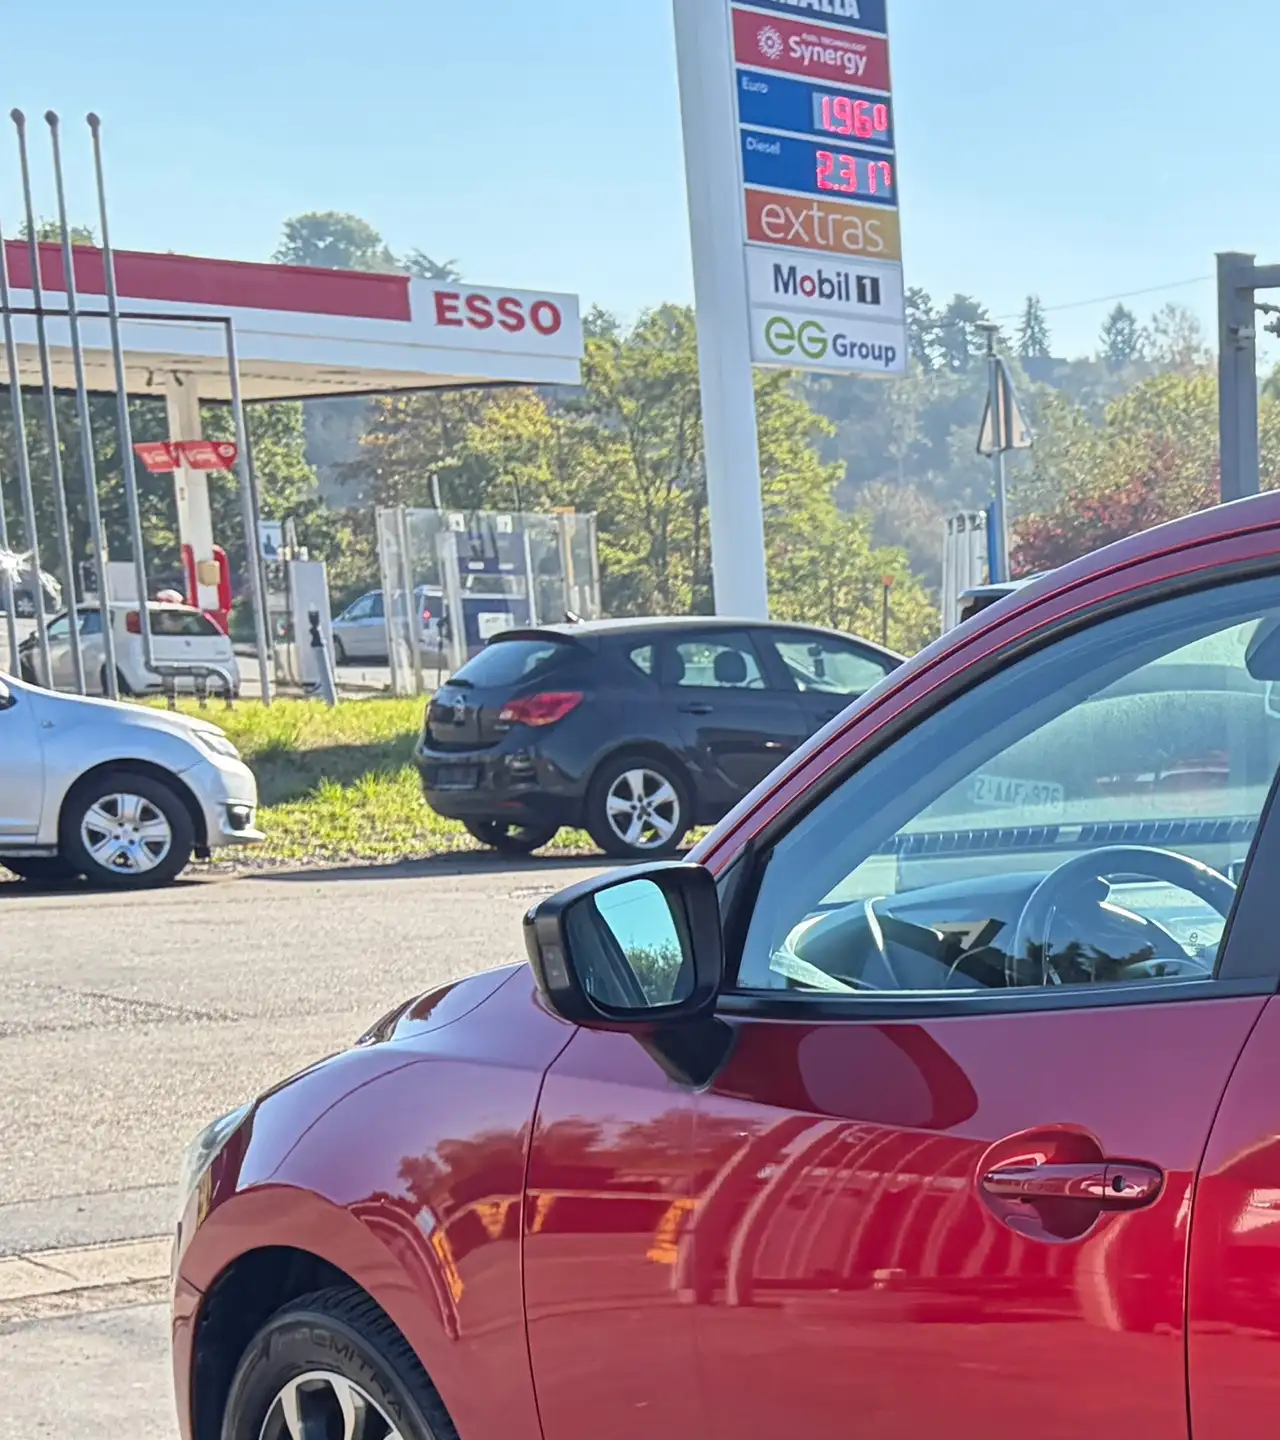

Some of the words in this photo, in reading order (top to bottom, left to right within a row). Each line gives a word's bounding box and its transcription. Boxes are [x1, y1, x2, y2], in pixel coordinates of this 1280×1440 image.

[788, 35, 867, 77] Synergy
[741, 76, 769, 94] Euro
[745, 137, 780, 155] Diesel
[761, 202, 884, 252] extras
[773, 263, 850, 302] Mobil
[433, 289, 562, 336] ESSO
[831, 332, 897, 366] Group
